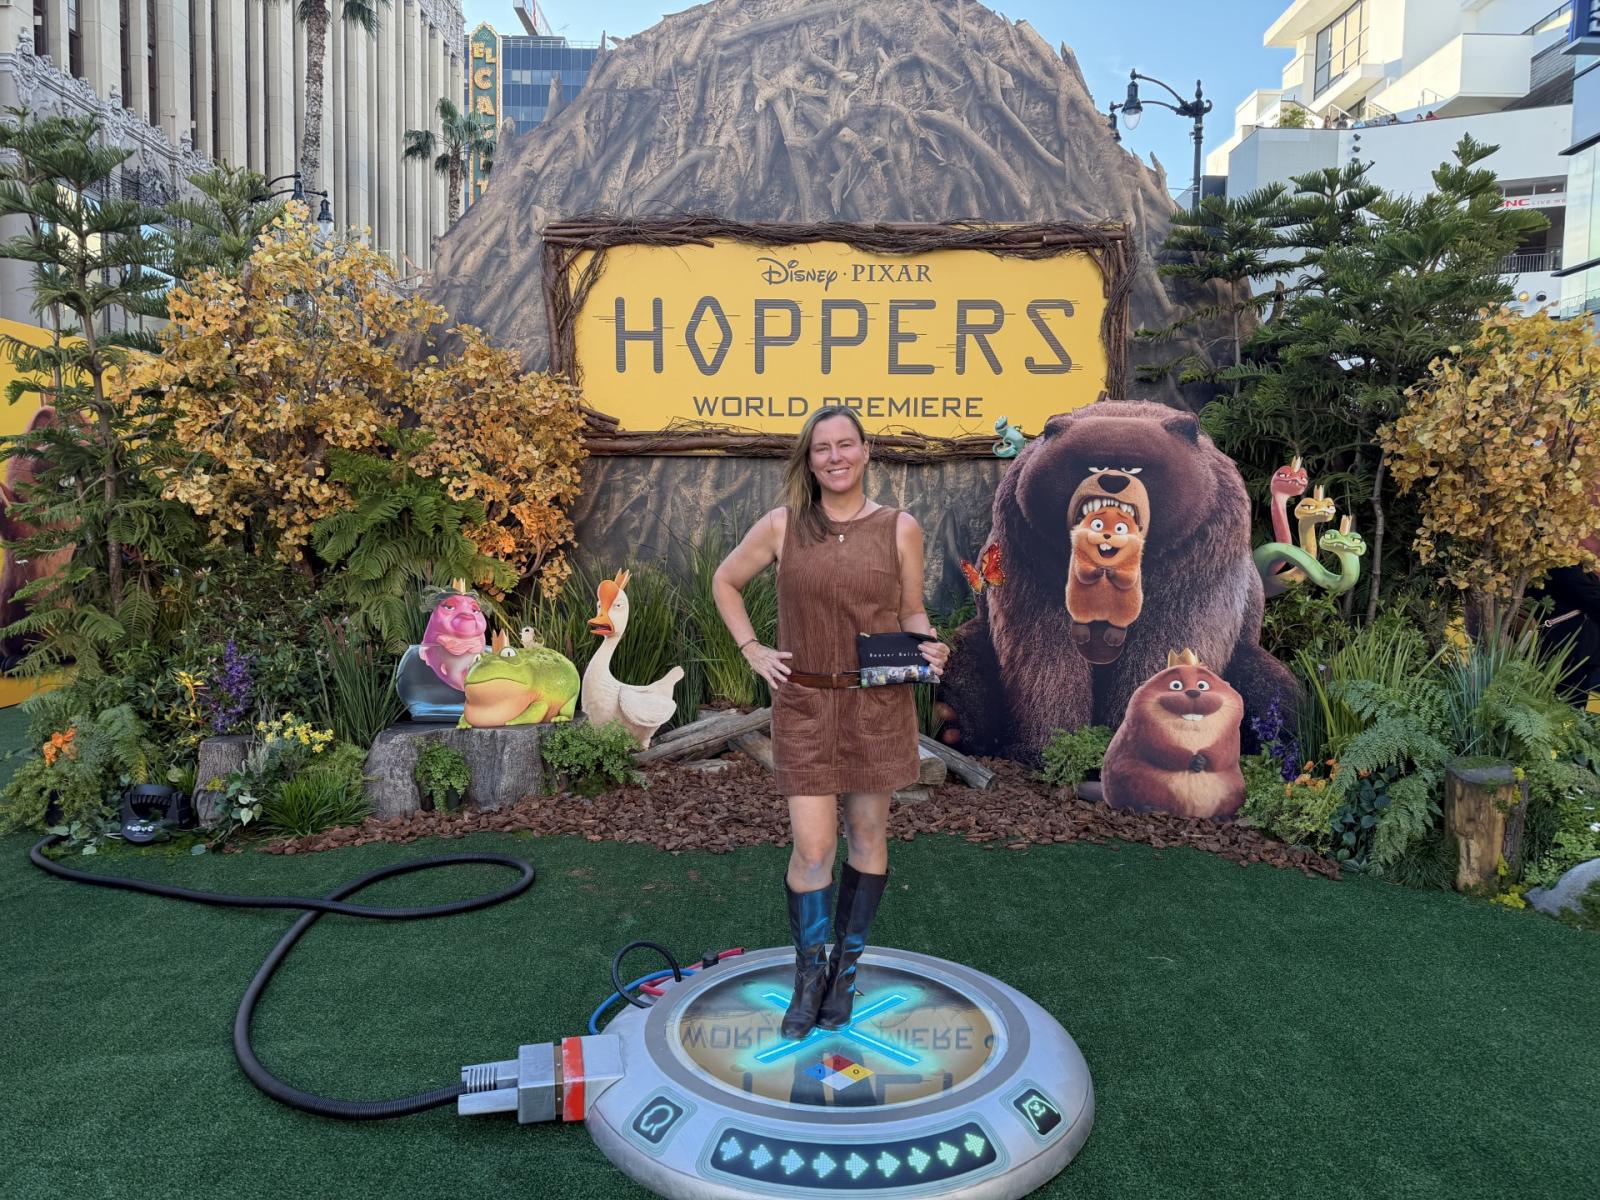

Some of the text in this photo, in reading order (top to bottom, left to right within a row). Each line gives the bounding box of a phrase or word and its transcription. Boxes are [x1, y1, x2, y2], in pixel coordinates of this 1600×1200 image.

[473, 43, 496, 63] EL
[756, 257, 932, 292] Disney PIXAR
[612, 295, 1080, 375] HOPPERS
[693, 396, 808, 416] WORLD
